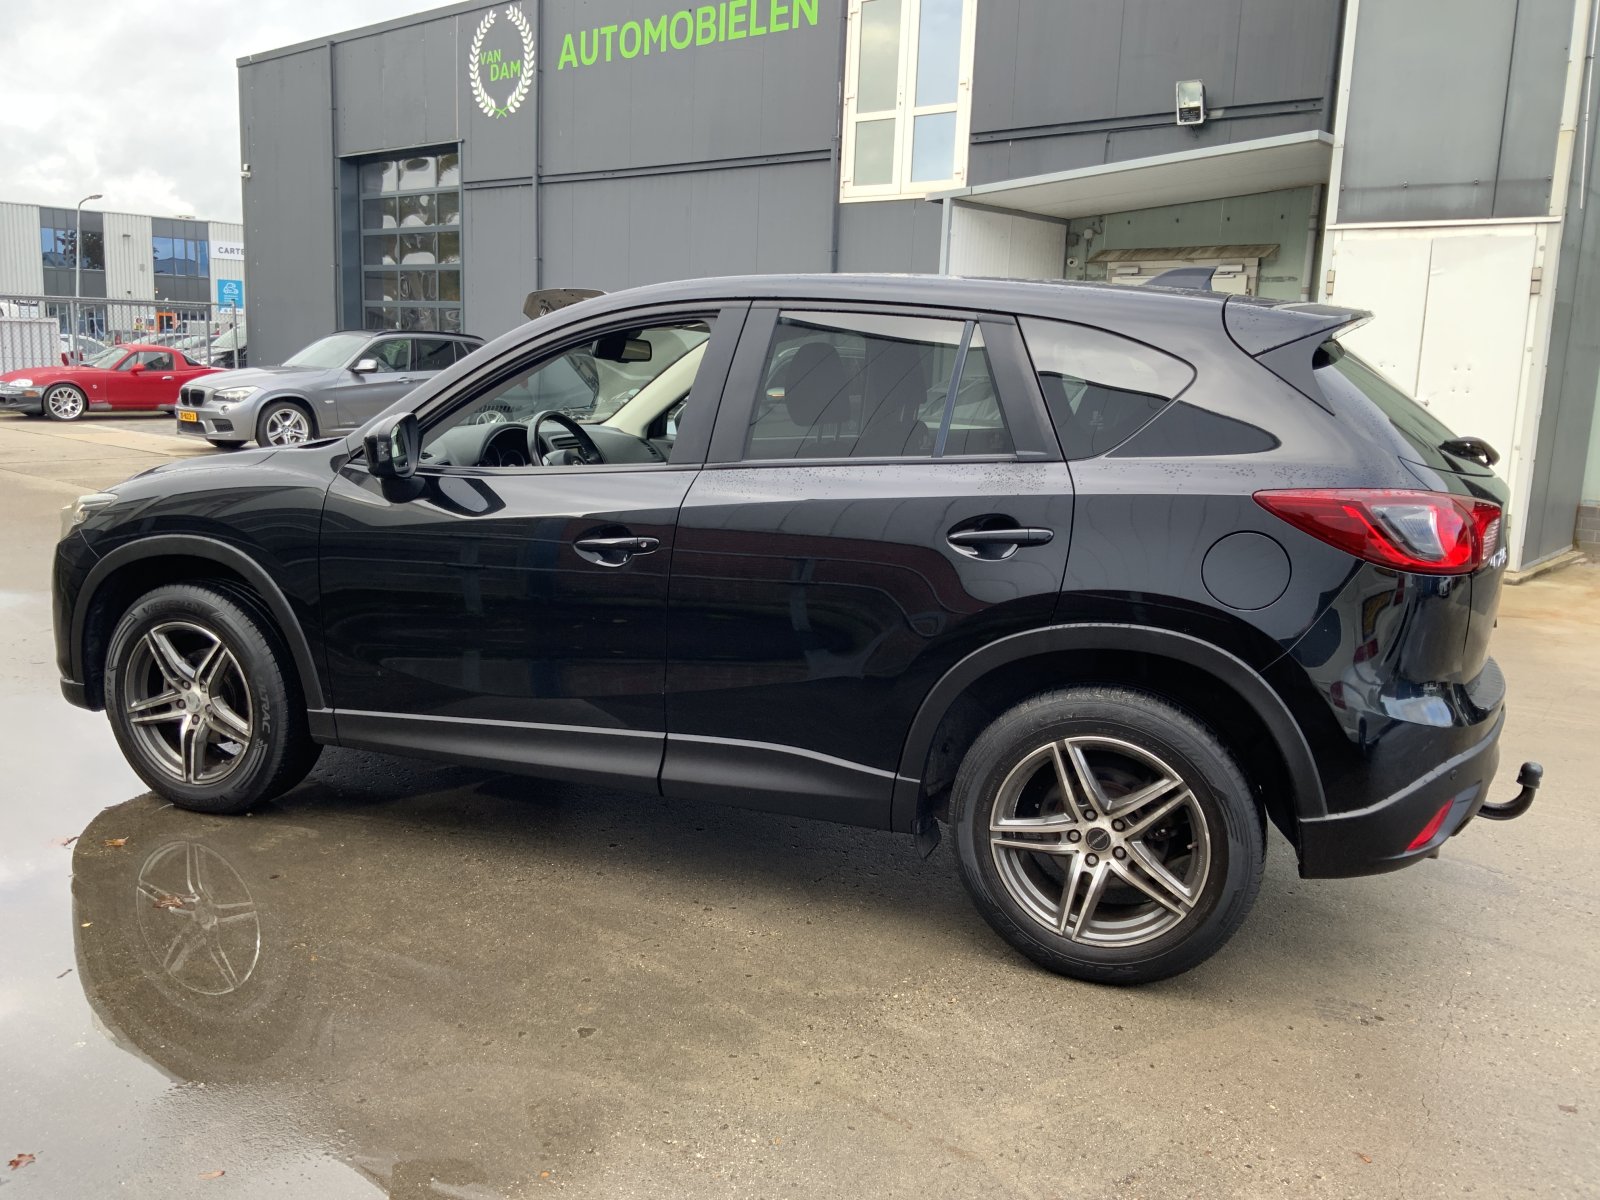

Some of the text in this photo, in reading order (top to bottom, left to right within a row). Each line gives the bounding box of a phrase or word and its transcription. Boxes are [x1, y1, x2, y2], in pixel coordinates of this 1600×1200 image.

[557, 0, 819, 70] AUTOMOBIELEN
[480, 49, 501, 65] VAN
[490, 60, 521, 81] DAM
